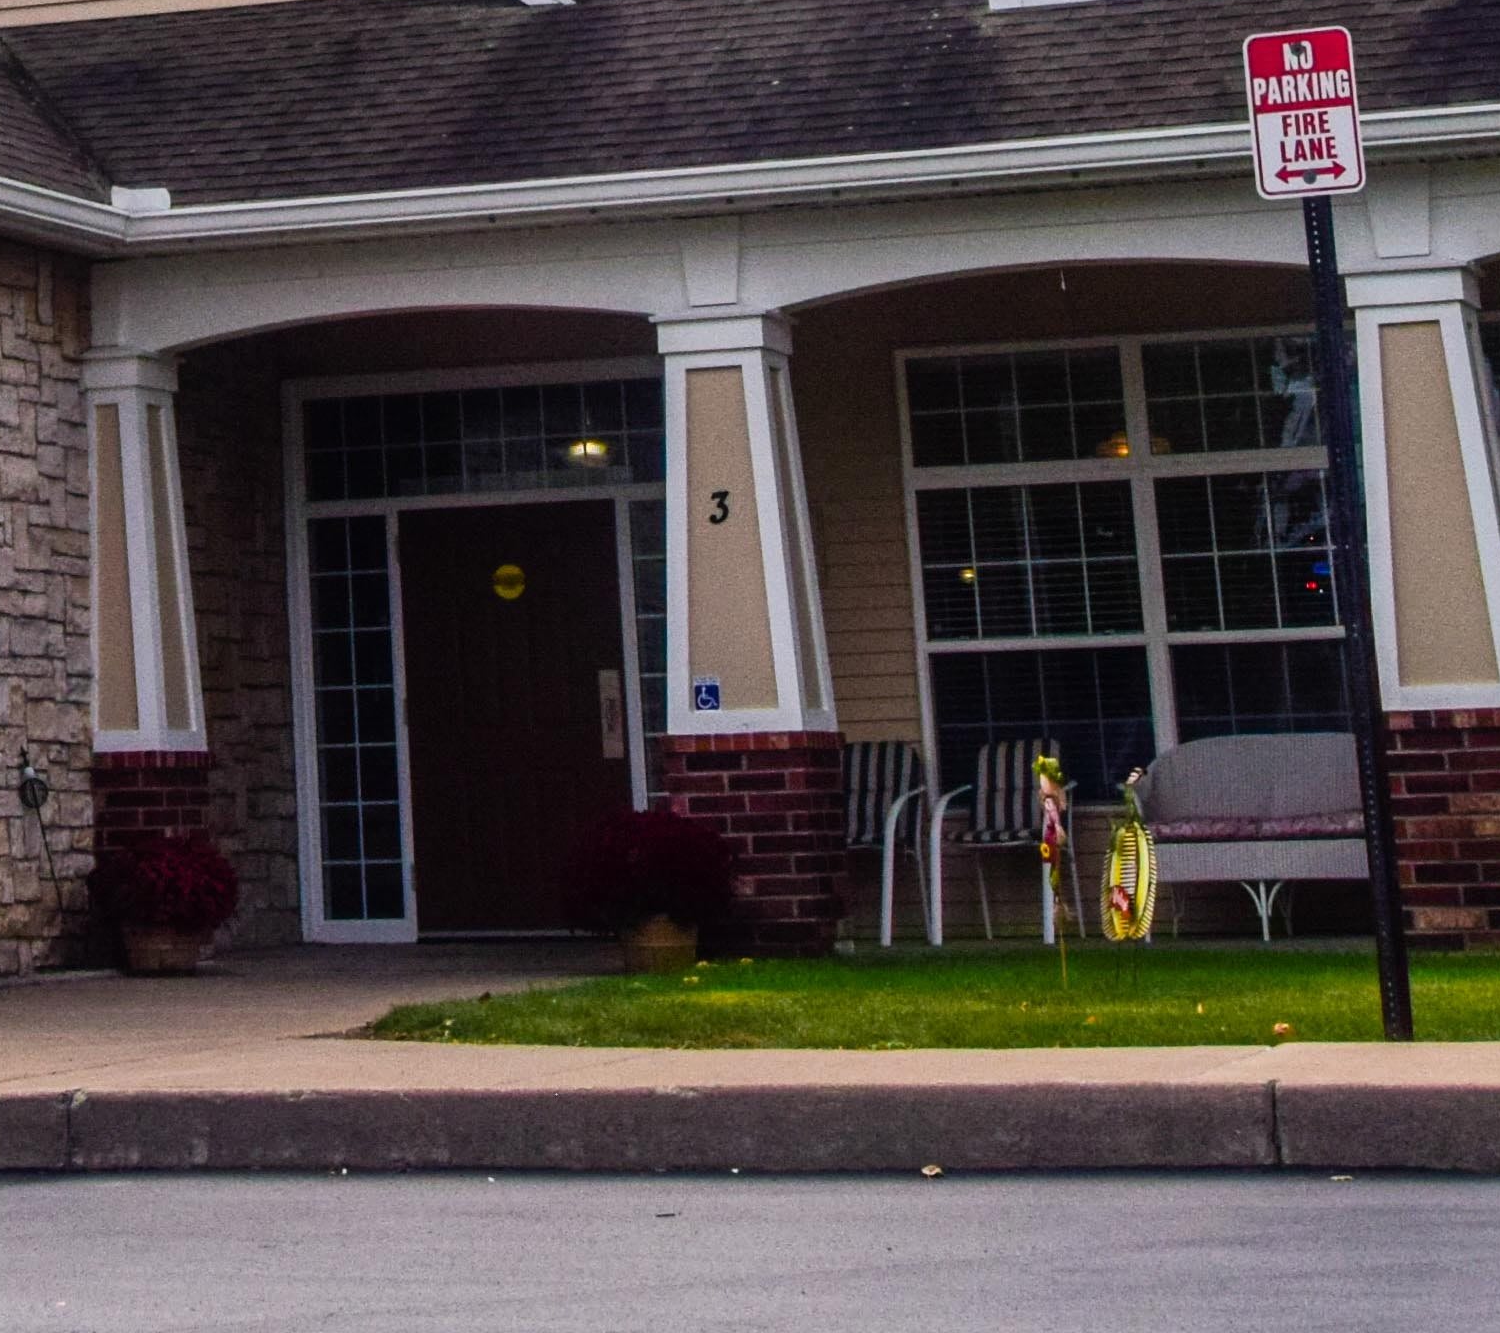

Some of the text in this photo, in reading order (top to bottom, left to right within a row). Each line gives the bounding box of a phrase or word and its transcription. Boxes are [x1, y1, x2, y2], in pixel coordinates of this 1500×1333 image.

[1282, 40, 1313, 71] NO
[1253, 69, 1350, 106] PARKING
[1281, 111, 1331, 137] FIRE
[1280, 137, 1338, 163] LANE
[709, 490, 730, 525] 3
